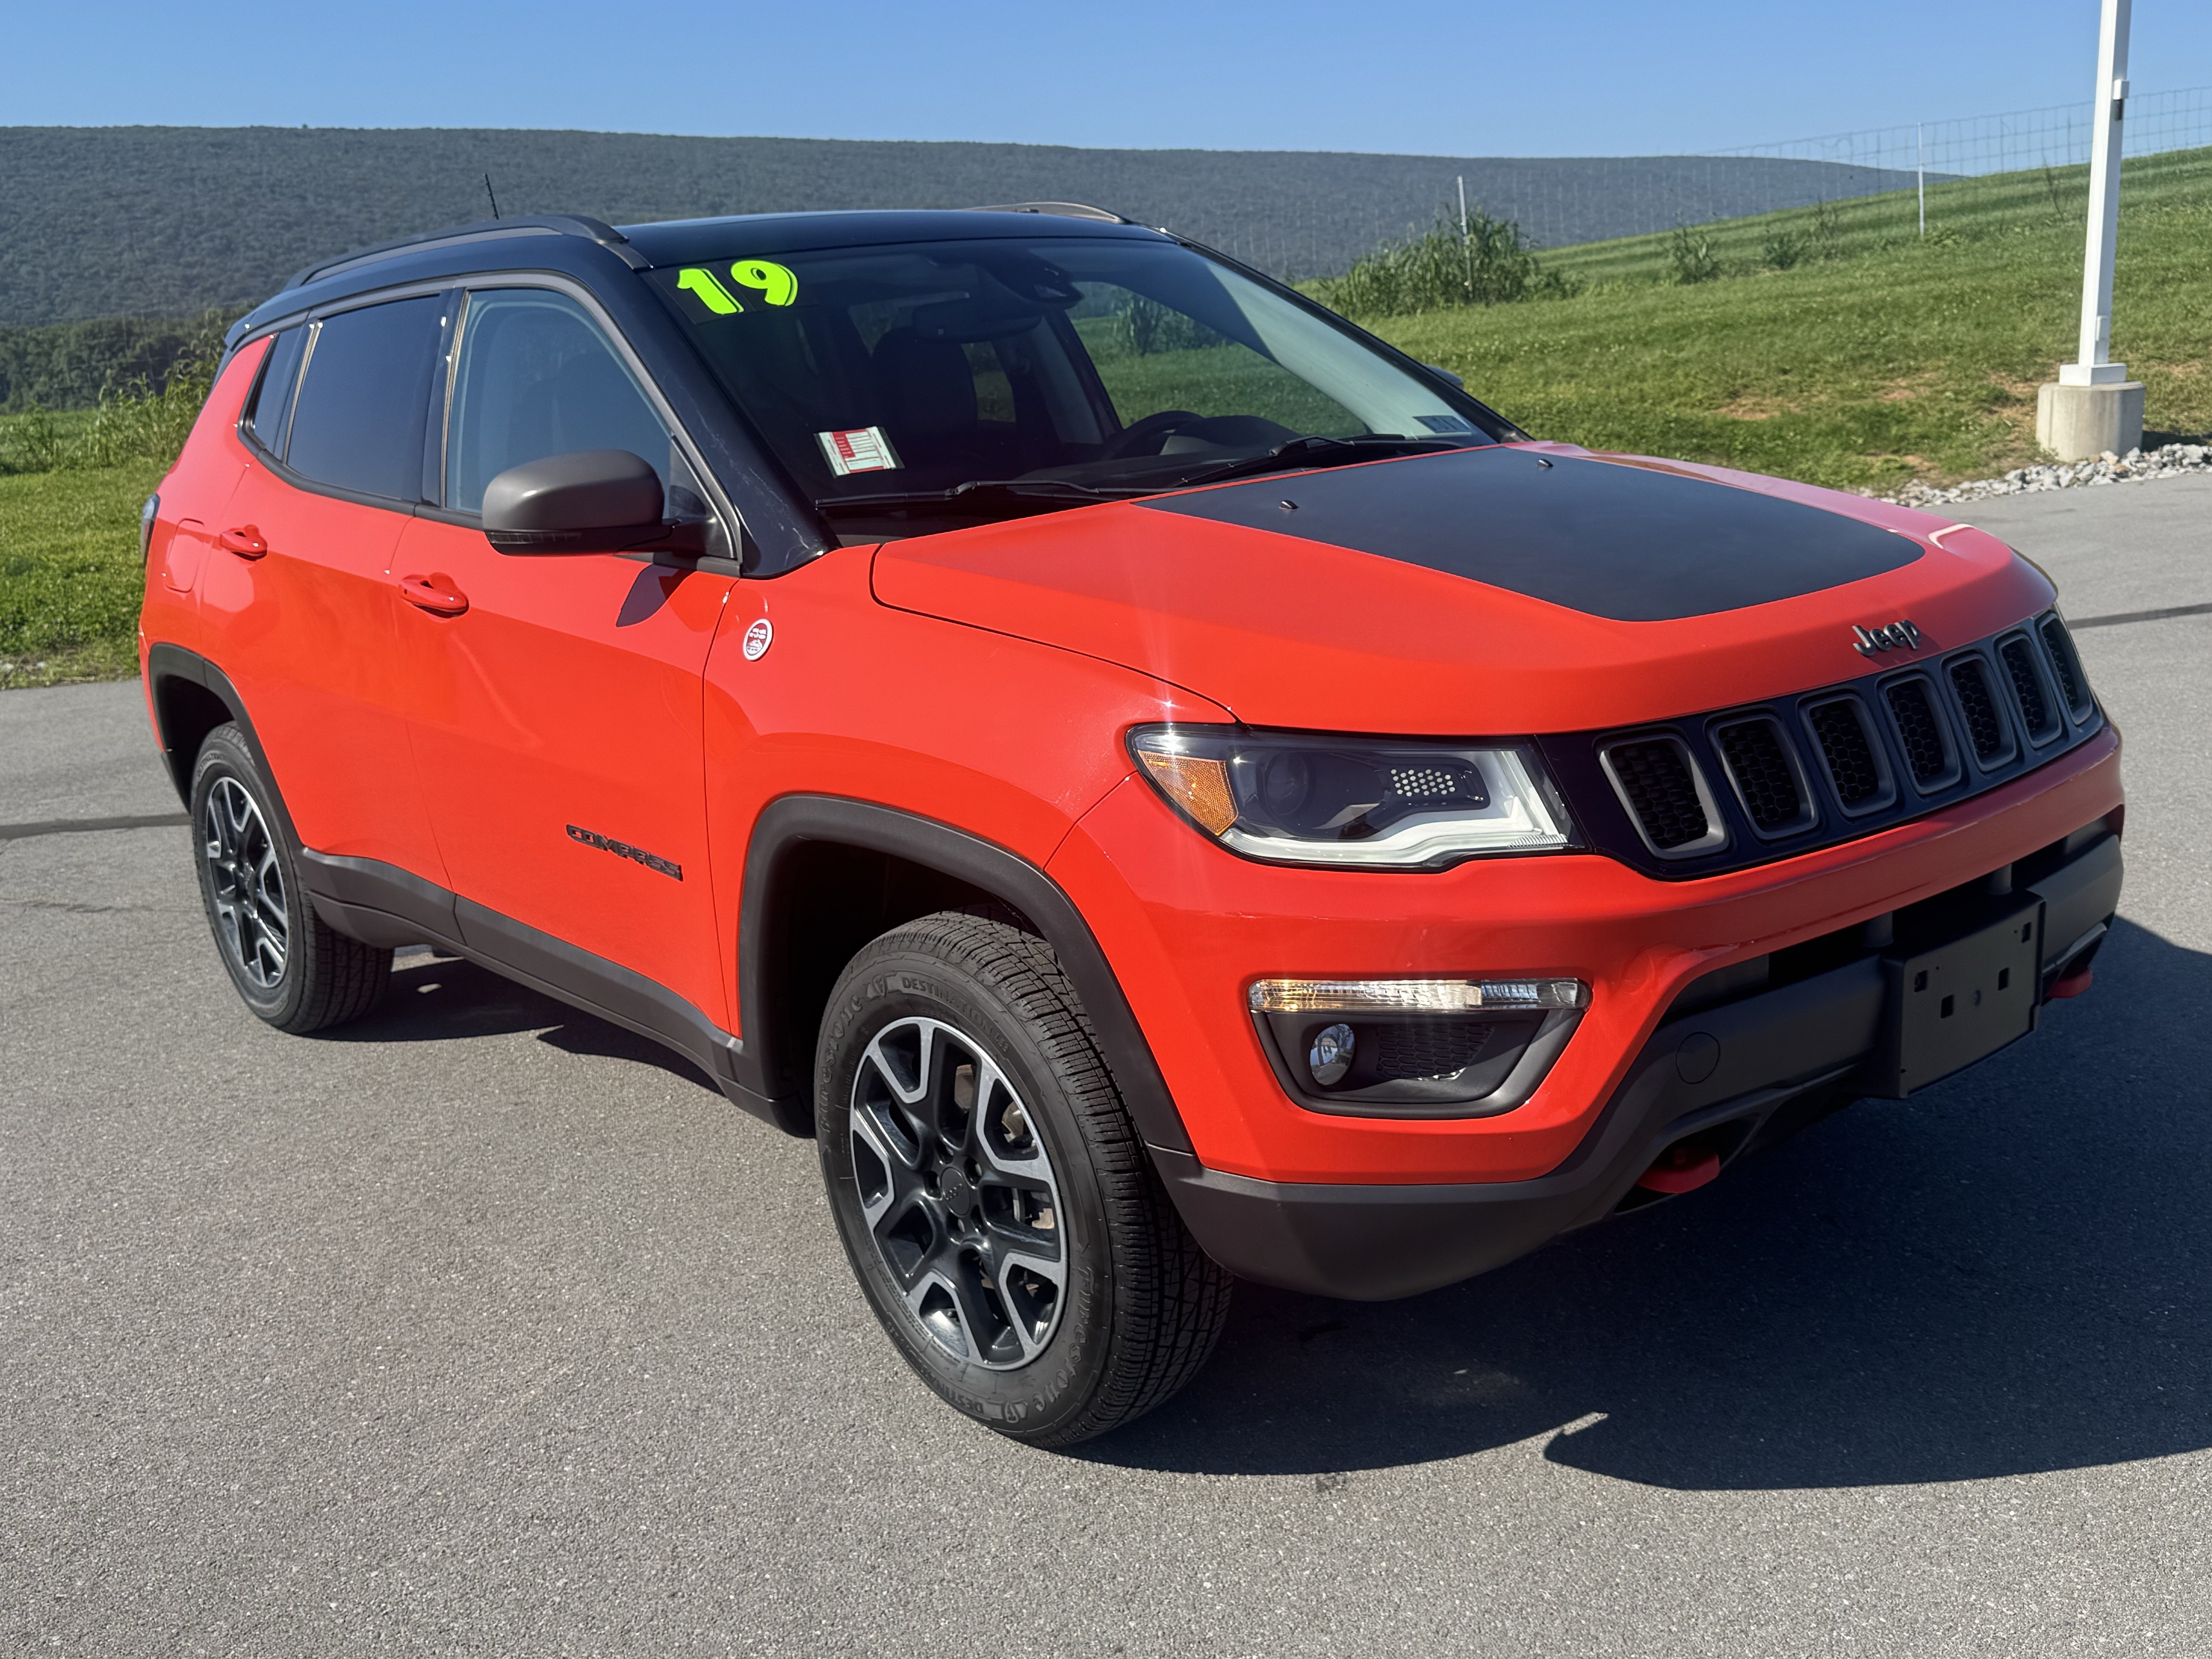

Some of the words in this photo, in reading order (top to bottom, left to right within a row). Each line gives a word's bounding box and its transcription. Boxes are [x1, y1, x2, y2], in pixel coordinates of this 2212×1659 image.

[677, 260, 799, 315] 19
[1851, 619, 1922, 656] Jeep
[566, 824, 684, 882] COMPASS
